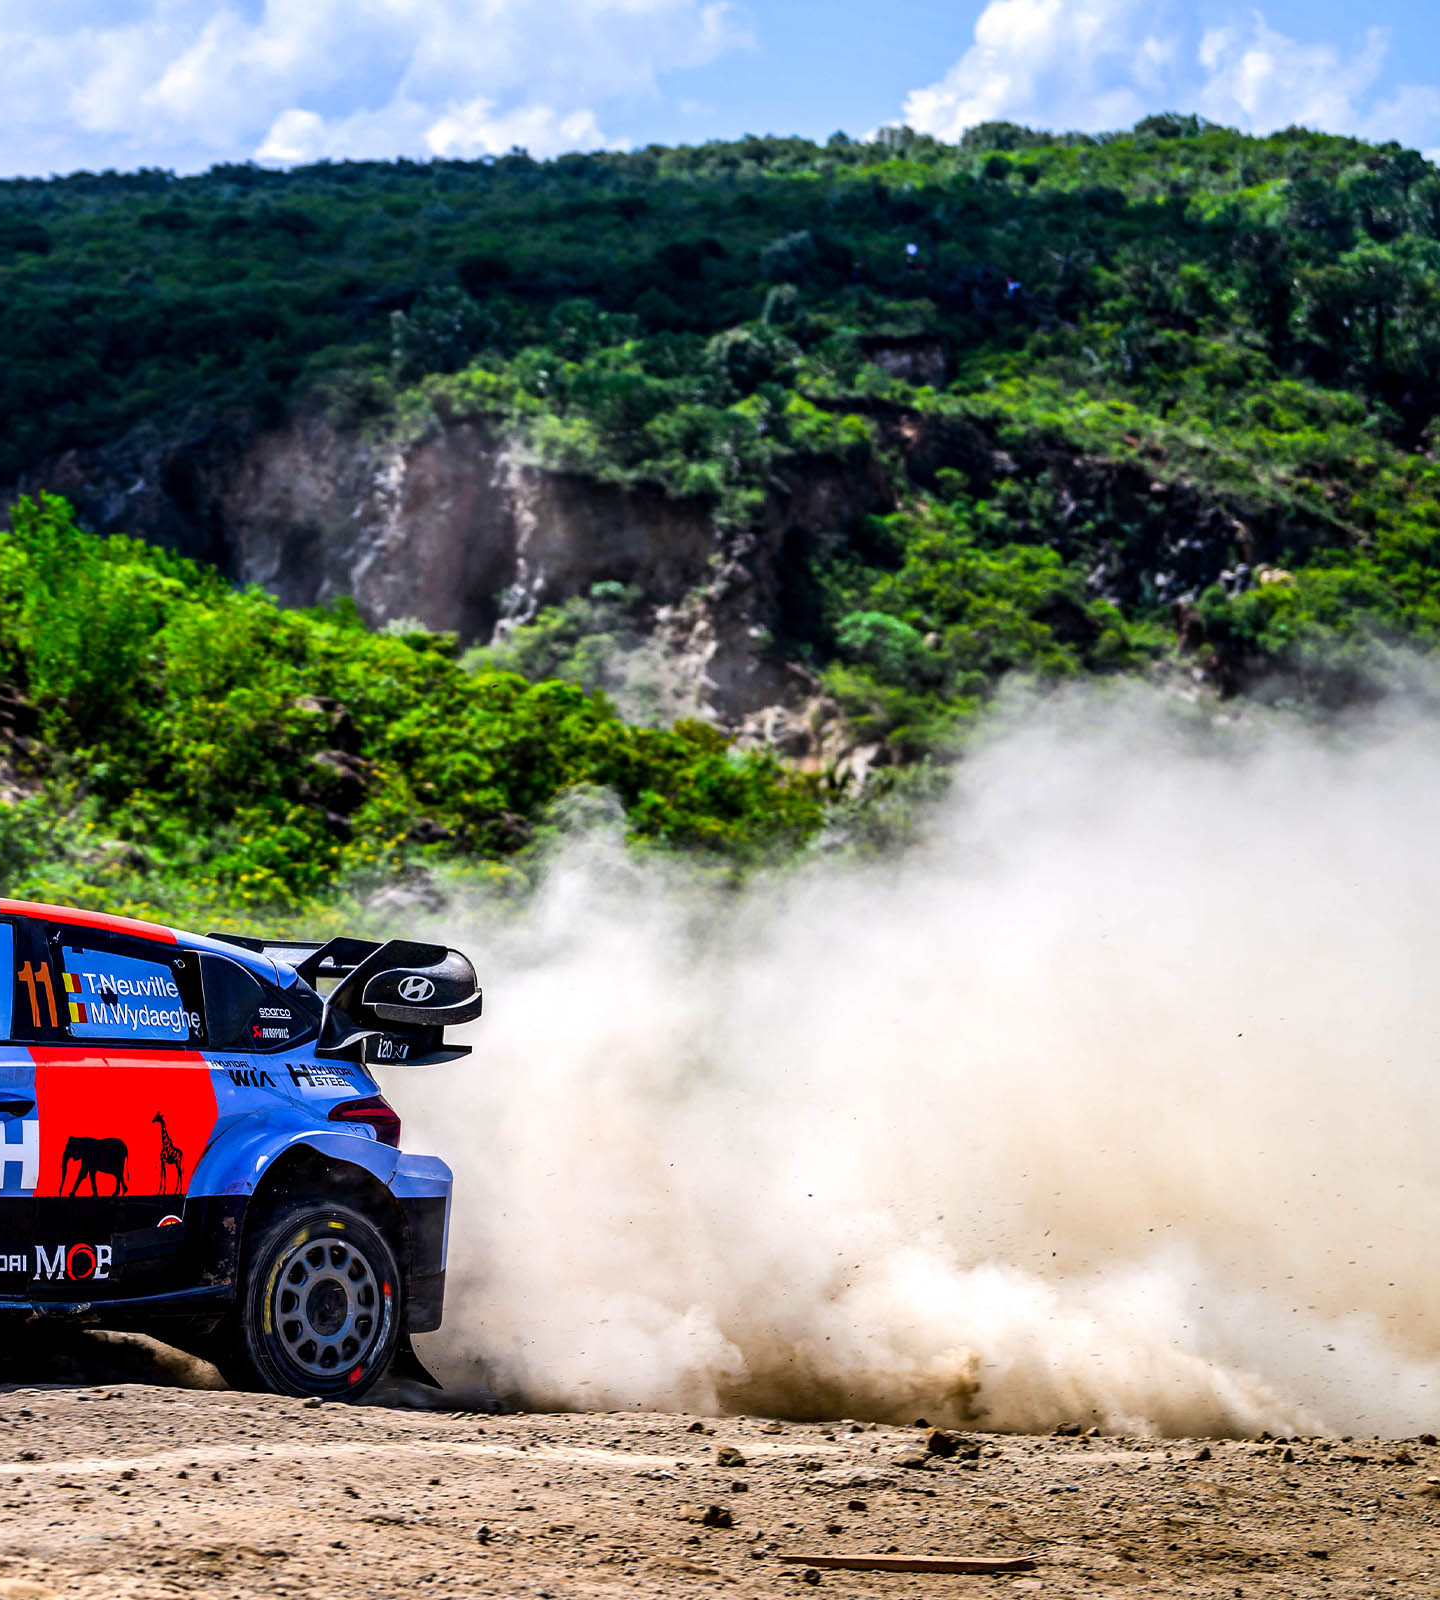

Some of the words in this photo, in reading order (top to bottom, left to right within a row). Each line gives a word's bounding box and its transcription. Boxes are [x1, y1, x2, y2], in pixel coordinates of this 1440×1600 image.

[18, 961, 58, 1027] 11
[82, 972, 179, 998] T.Neuville
[90, 1002, 201, 1033] M.Wydaeghe
[258, 1007, 292, 1019] sparco
[210, 1059, 250, 1069] HYUNDAI
